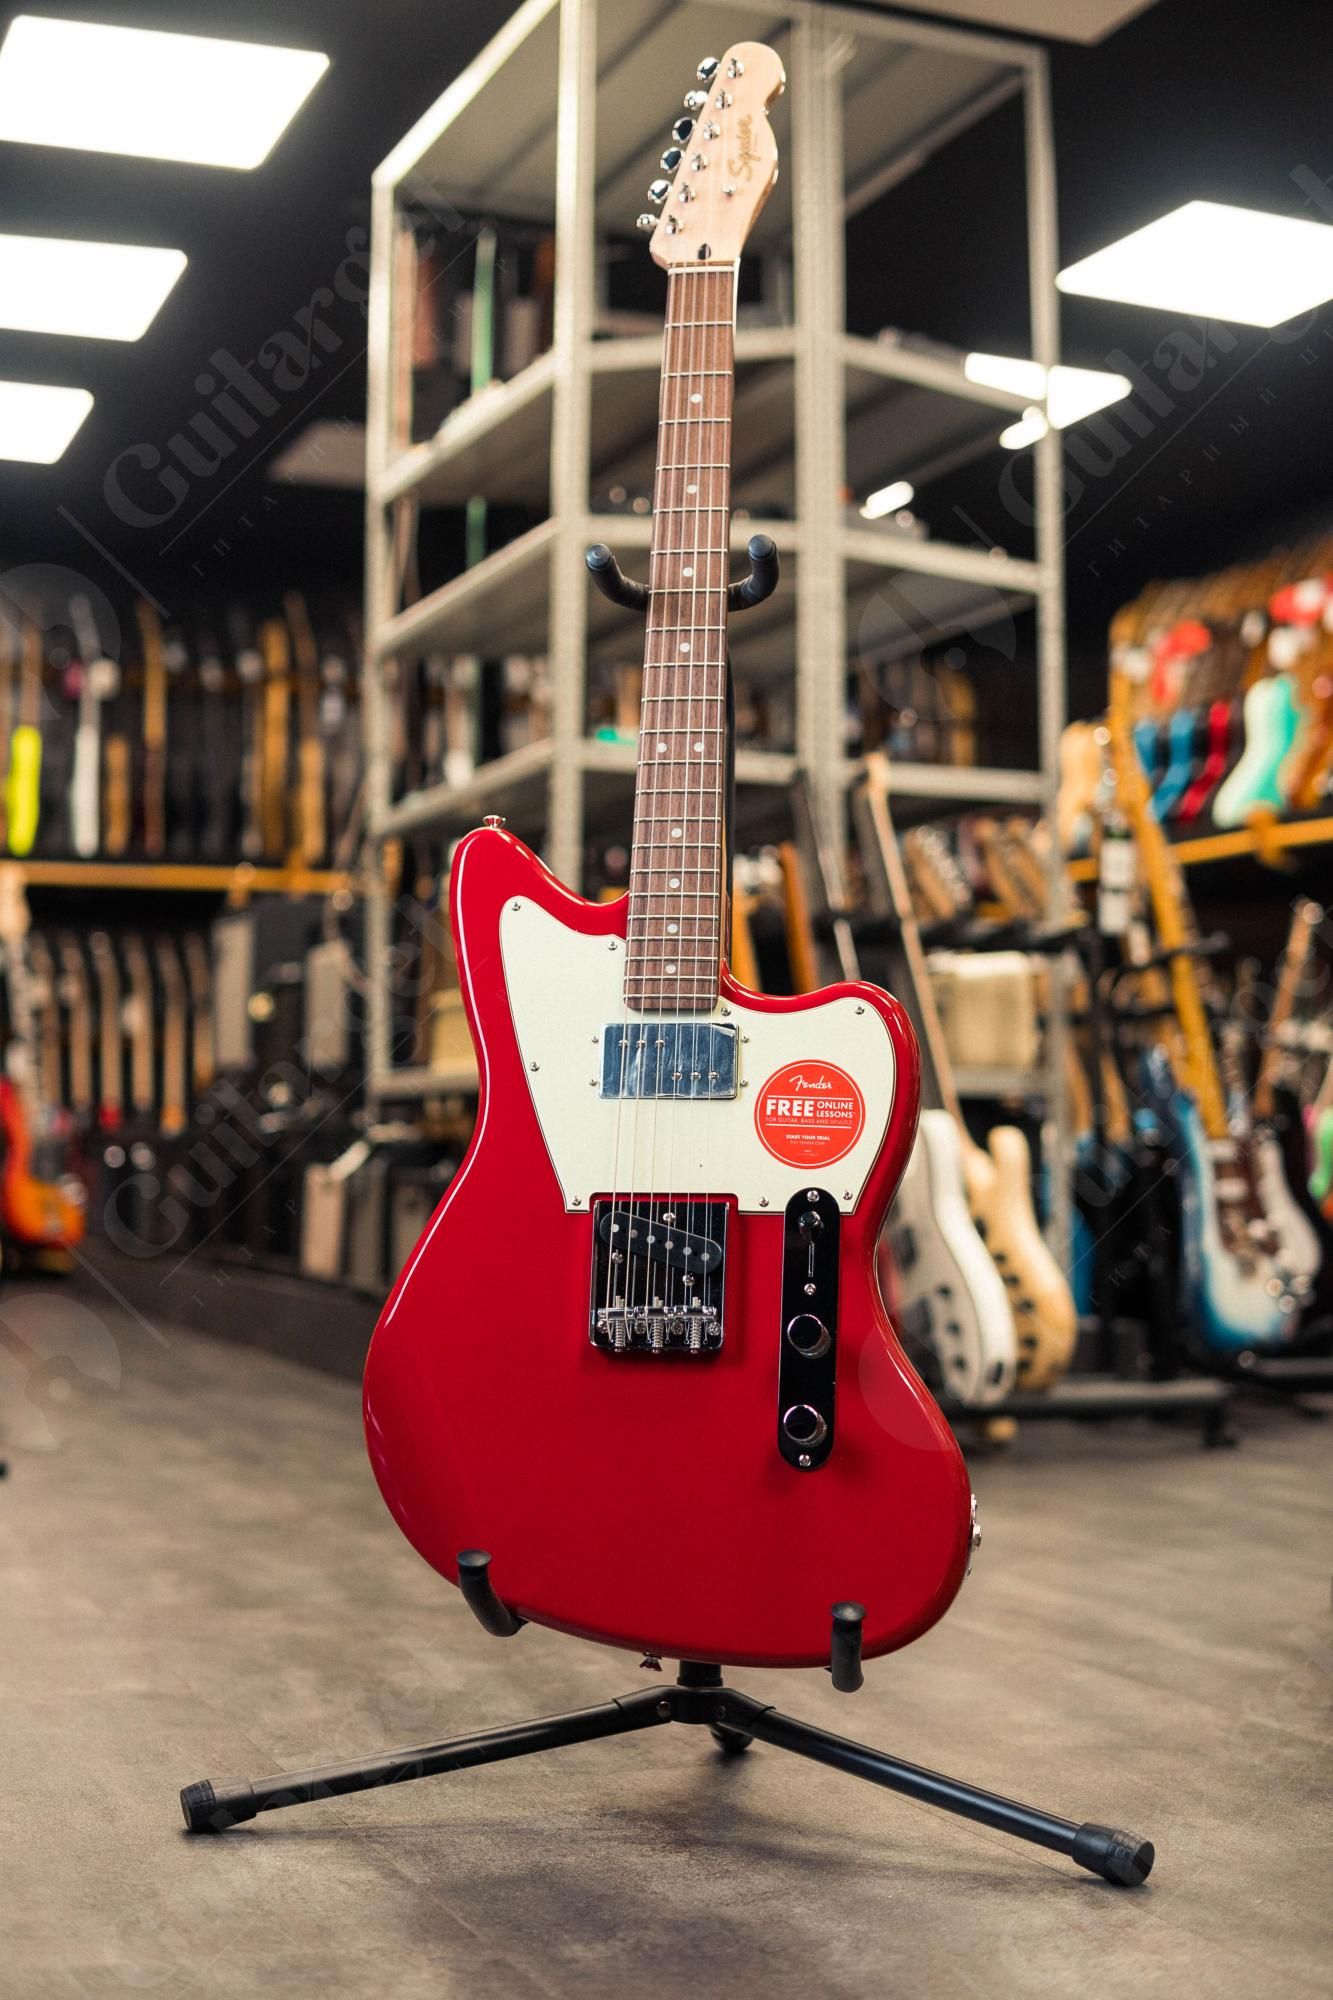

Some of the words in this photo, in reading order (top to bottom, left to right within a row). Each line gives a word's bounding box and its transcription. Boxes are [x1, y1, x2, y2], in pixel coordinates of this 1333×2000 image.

[789, 1074, 832, 1092] Fender
[766, 1099, 815, 1117] FREE
[817, 1100, 854, 1110] ONLINE
[816, 1110, 853, 1119] LESSONS
